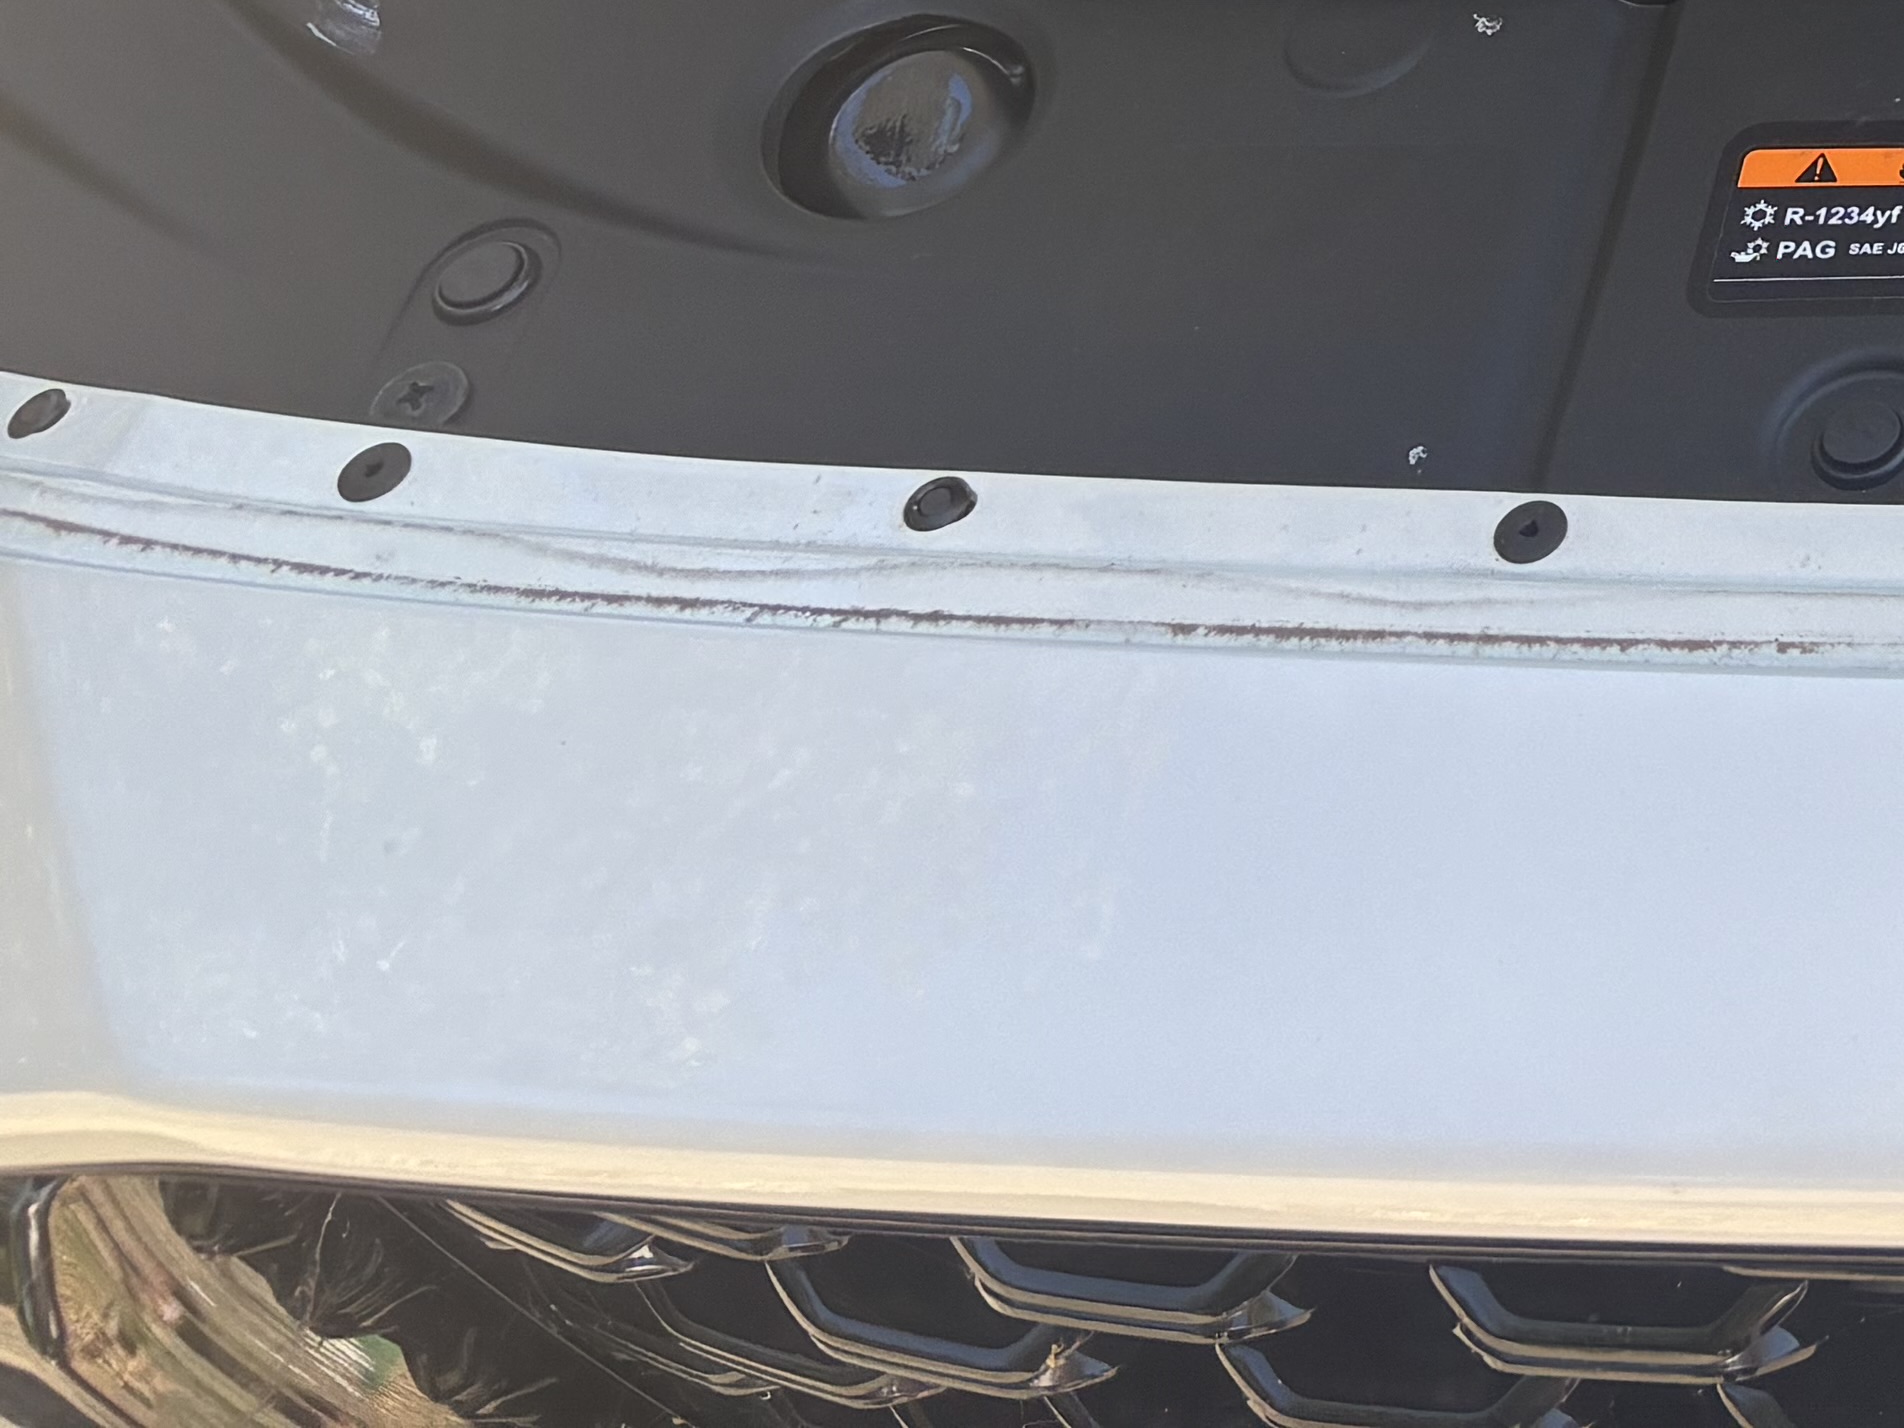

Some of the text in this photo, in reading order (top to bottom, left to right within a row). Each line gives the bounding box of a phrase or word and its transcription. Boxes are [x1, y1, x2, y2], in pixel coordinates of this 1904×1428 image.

[1784, 205, 1903, 229] R-1234yf
[1776, 240, 1836, 260] PAG
[1848, 242, 1884, 255] SAE
